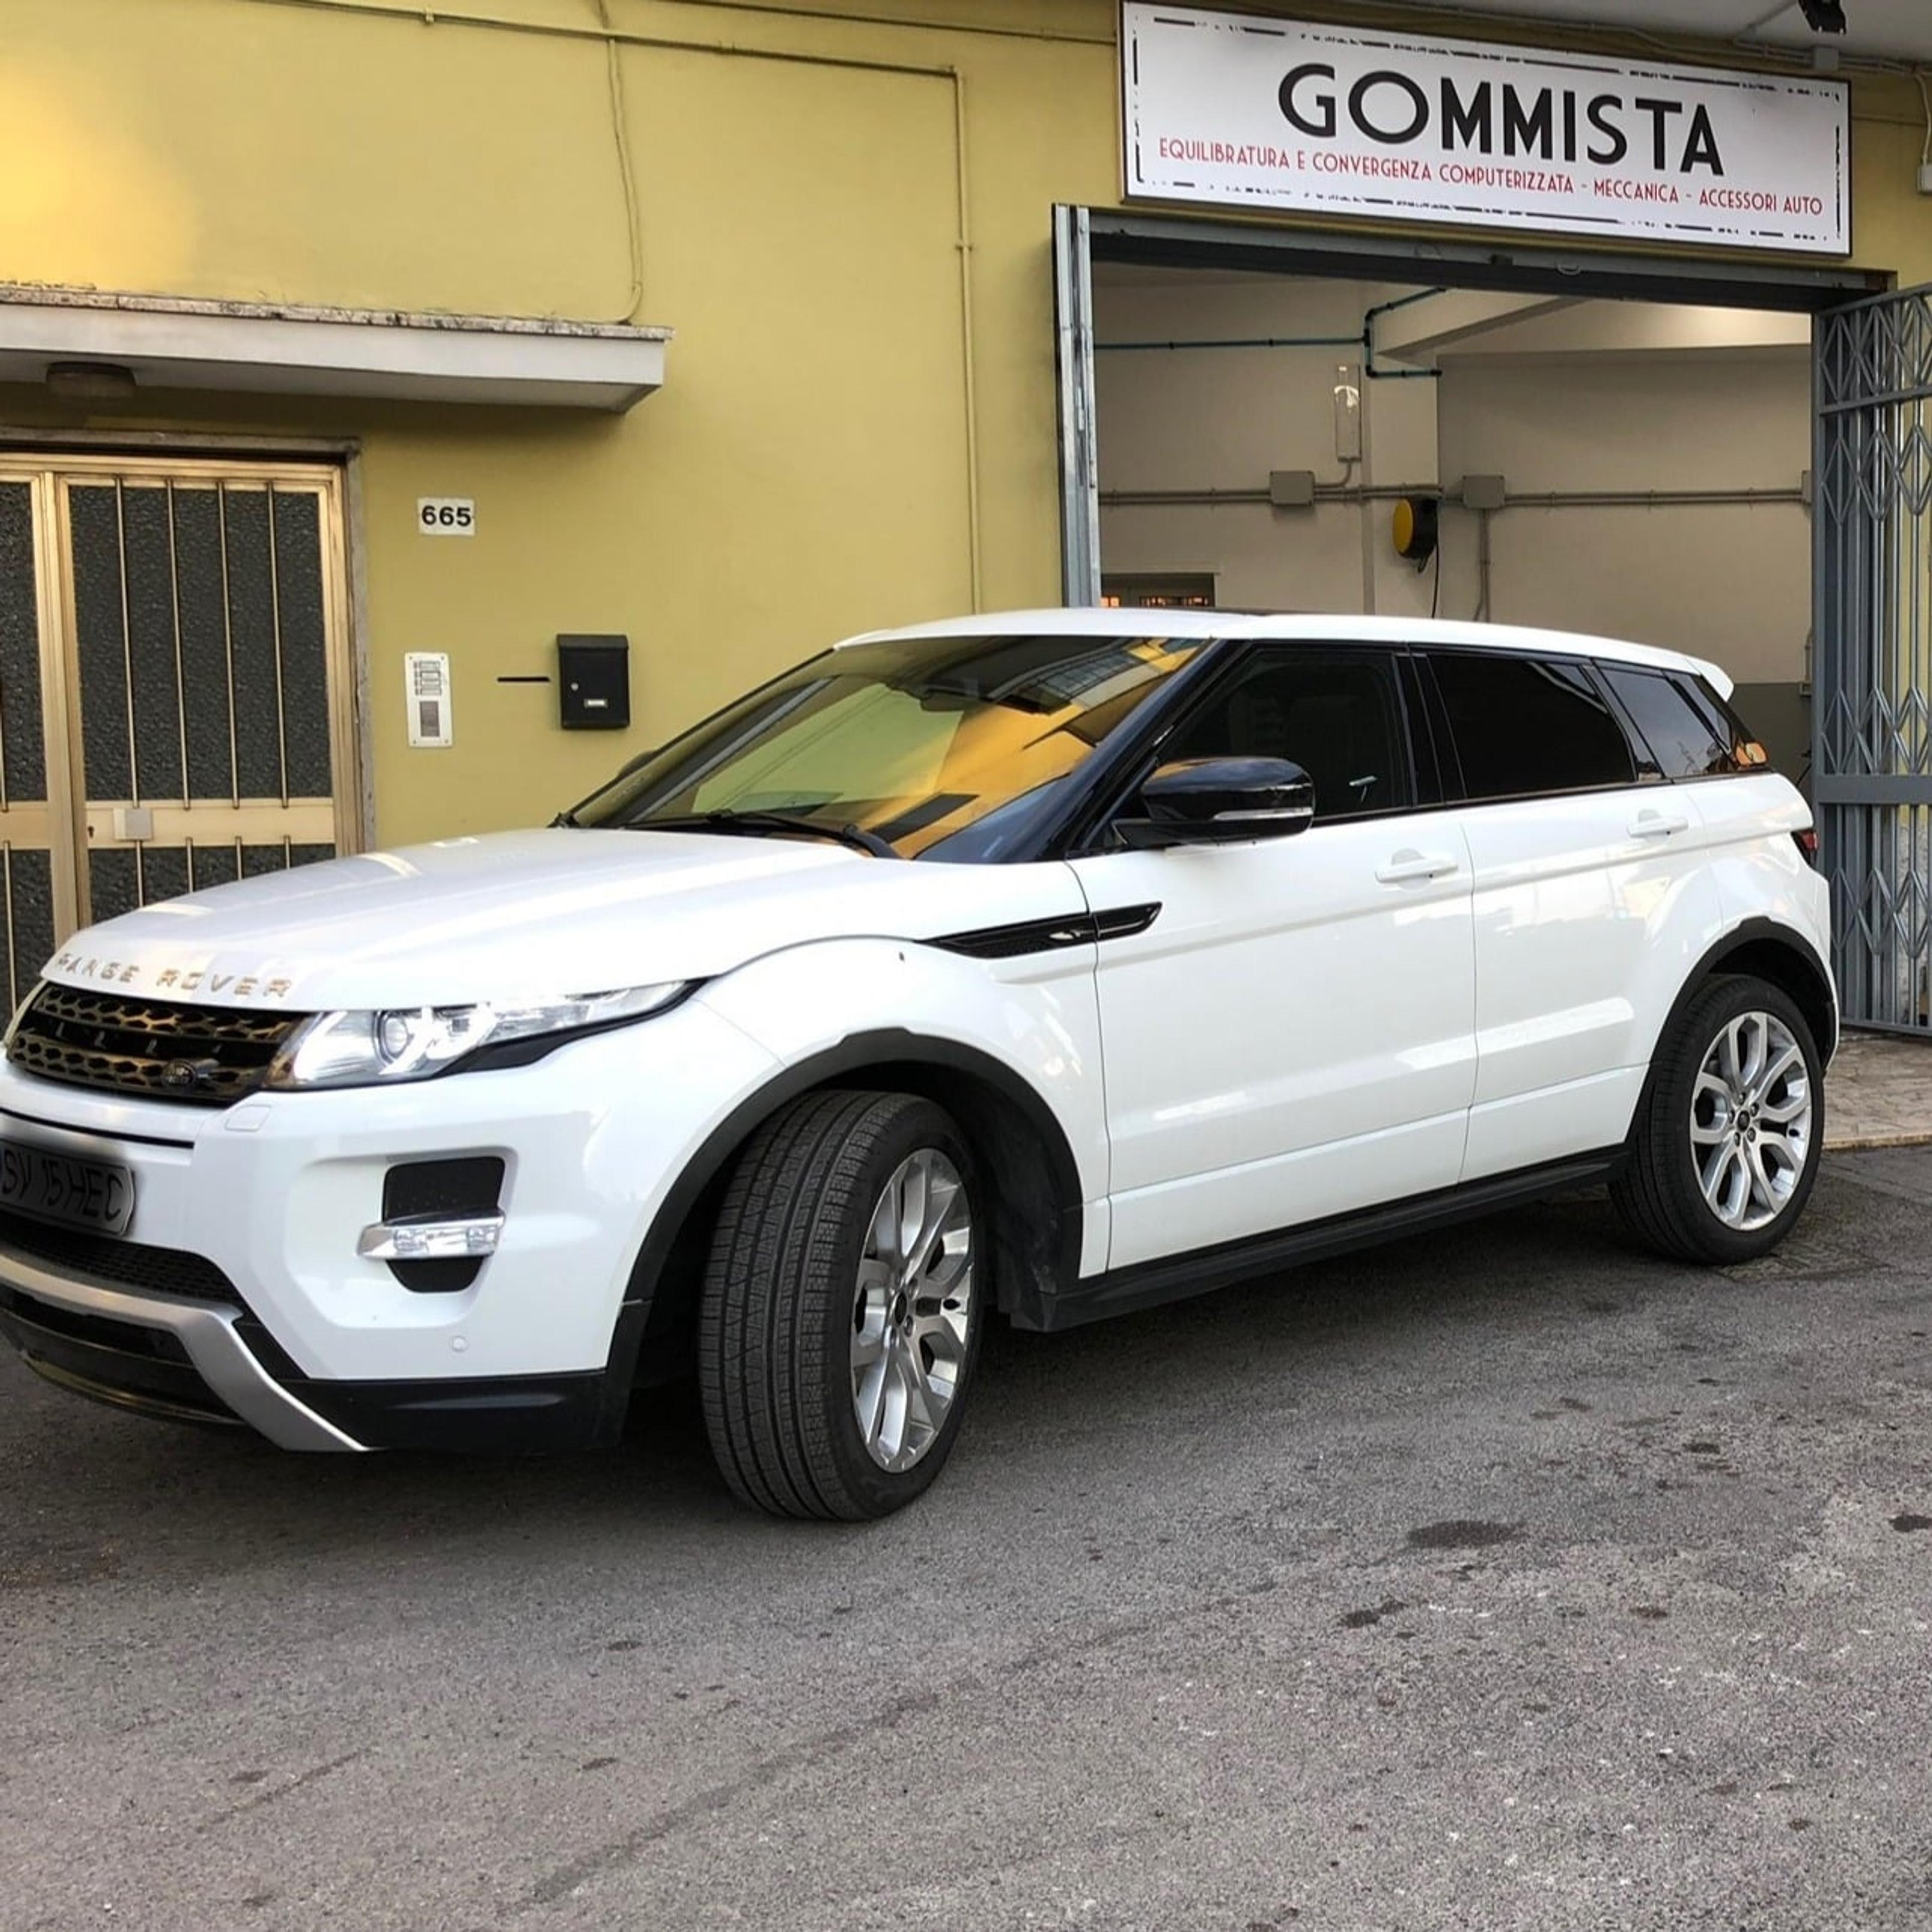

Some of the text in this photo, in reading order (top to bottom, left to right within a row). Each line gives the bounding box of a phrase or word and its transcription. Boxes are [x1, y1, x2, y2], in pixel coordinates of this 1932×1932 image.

[1278, 63, 1724, 176] GOMMISTA
[1160, 138, 1289, 169] EQUILIBRATURA
[1298, 151, 1305, 169] E
[1313, 153, 1431, 181] CONVERGENZA
[1439, 165, 1573, 193] COMPUTERIZZATA
[1594, 180, 1678, 202] MECCANICA
[1700, 190, 1777, 211] ACCESSORI
[1784, 198, 1823, 215] AUTO
[422, 506, 471, 526] 665
[156, 969, 292, 997] ROVER
